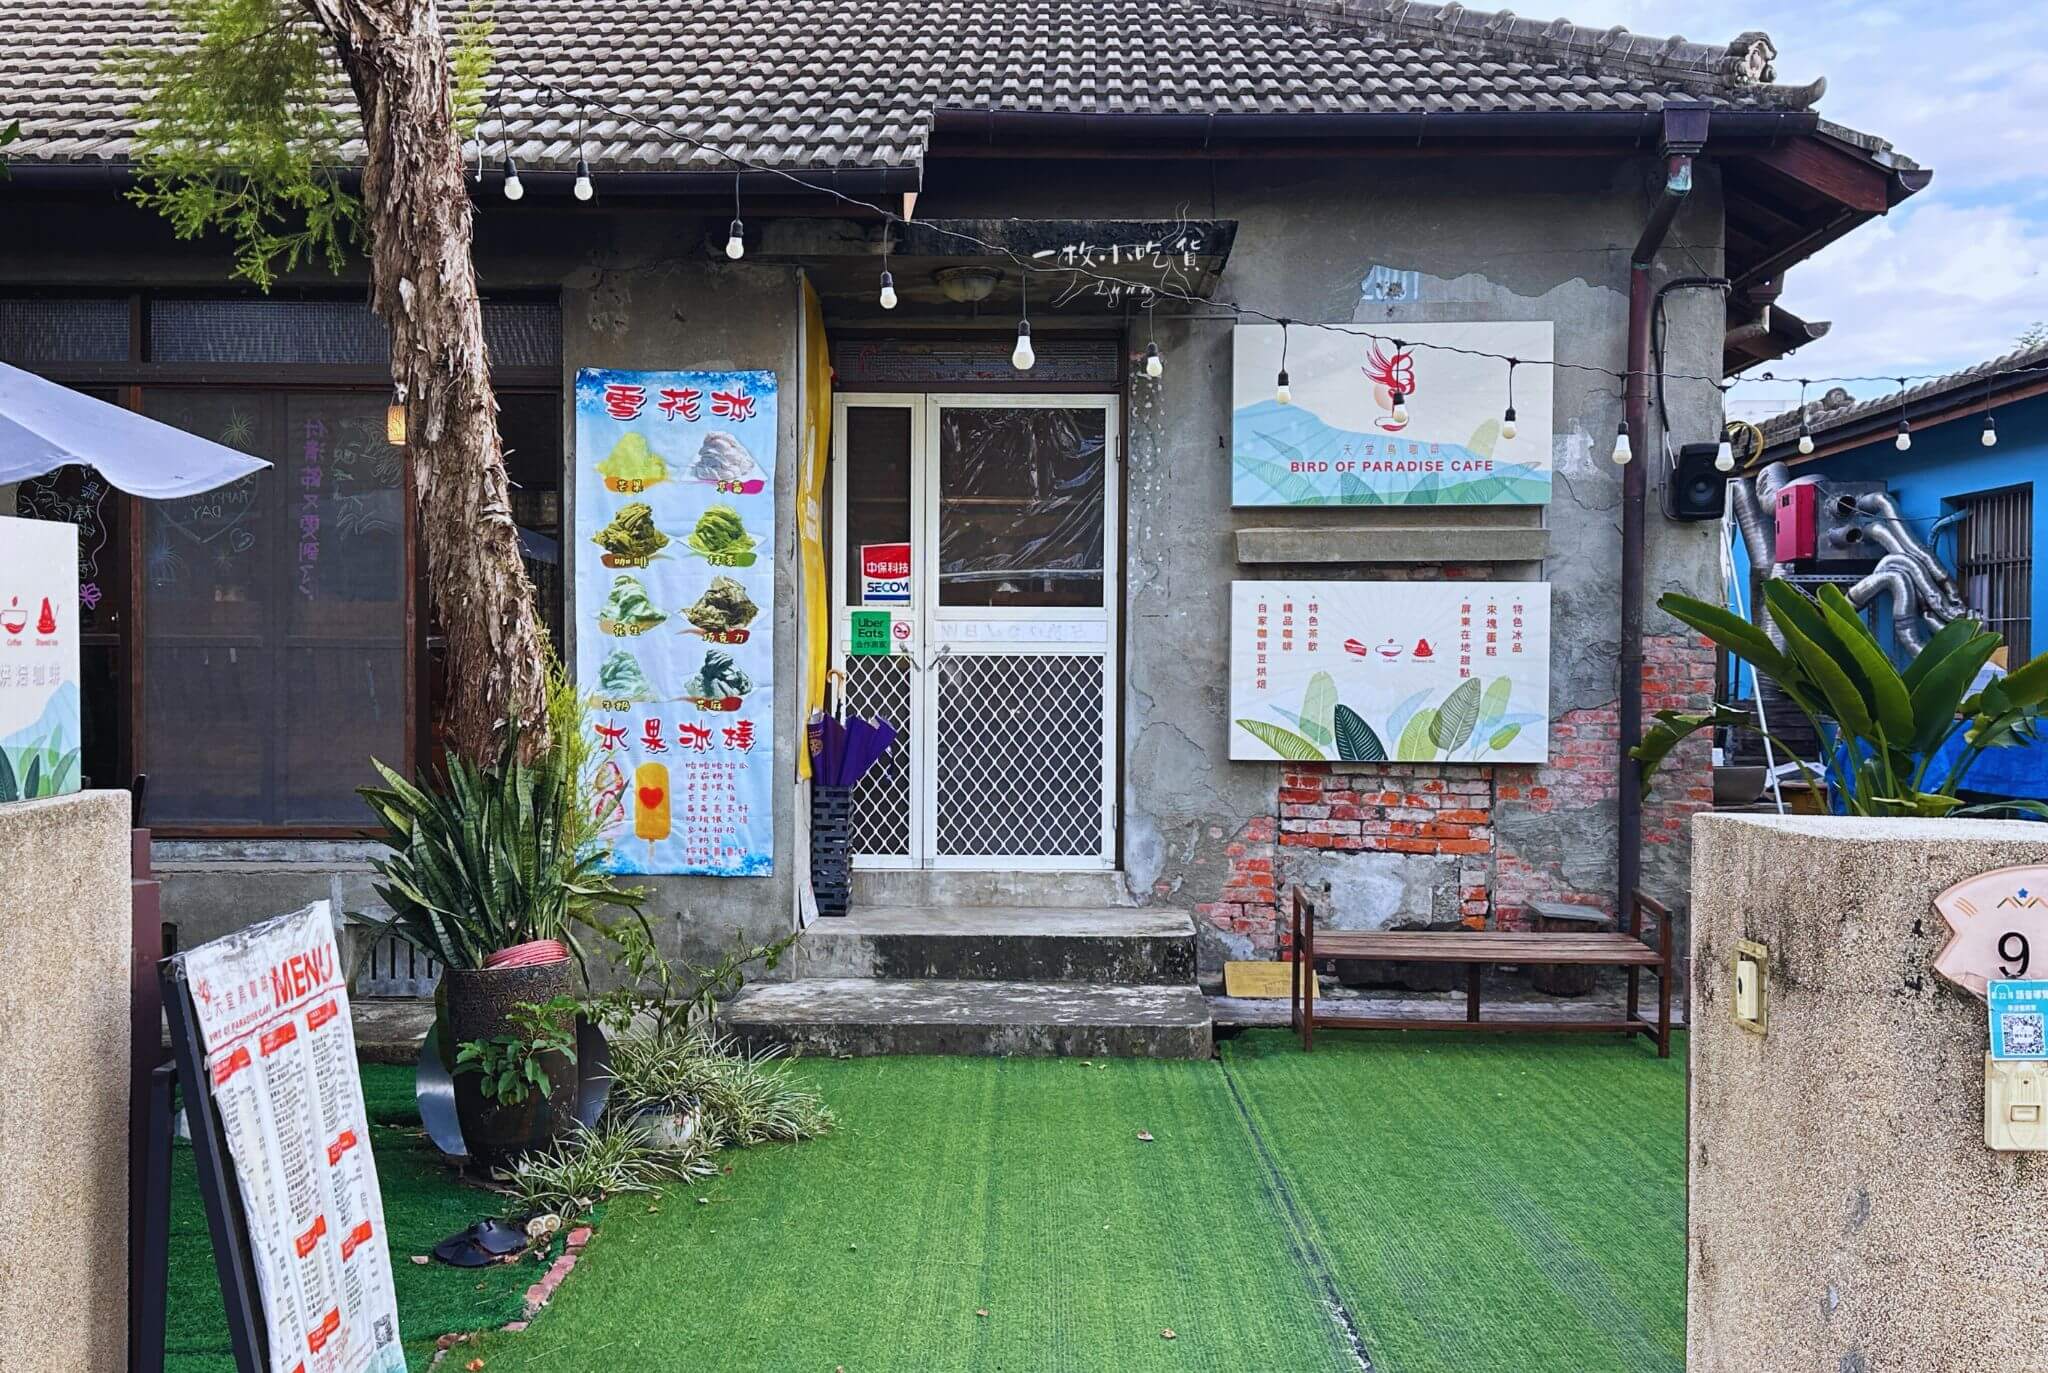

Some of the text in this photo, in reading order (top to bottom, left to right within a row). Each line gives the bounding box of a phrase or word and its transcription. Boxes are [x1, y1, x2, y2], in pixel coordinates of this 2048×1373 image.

[604, 383, 757, 421] 雪花冰
[1290, 459, 1494, 473] BIRD OF PARADISE CAFE
[614, 556, 649, 569] 咖啡
[866, 561, 910, 574] 中保科技
[867, 582, 909, 592] SECOM
[857, 618, 884, 628] Uber
[857, 628, 884, 638] Eats
[1308, 603, 1319, 652] 特色茶飲
[1512, 604, 1523, 653] 特色冰品
[703, 631, 745, 644] 巧克力
[1460, 604, 1471, 678] 屏東在地甜點
[594, 718, 757, 754] 水果冰棒
[1997, 932, 2030, 979] 9
[270, 943, 333, 1008] MENU
